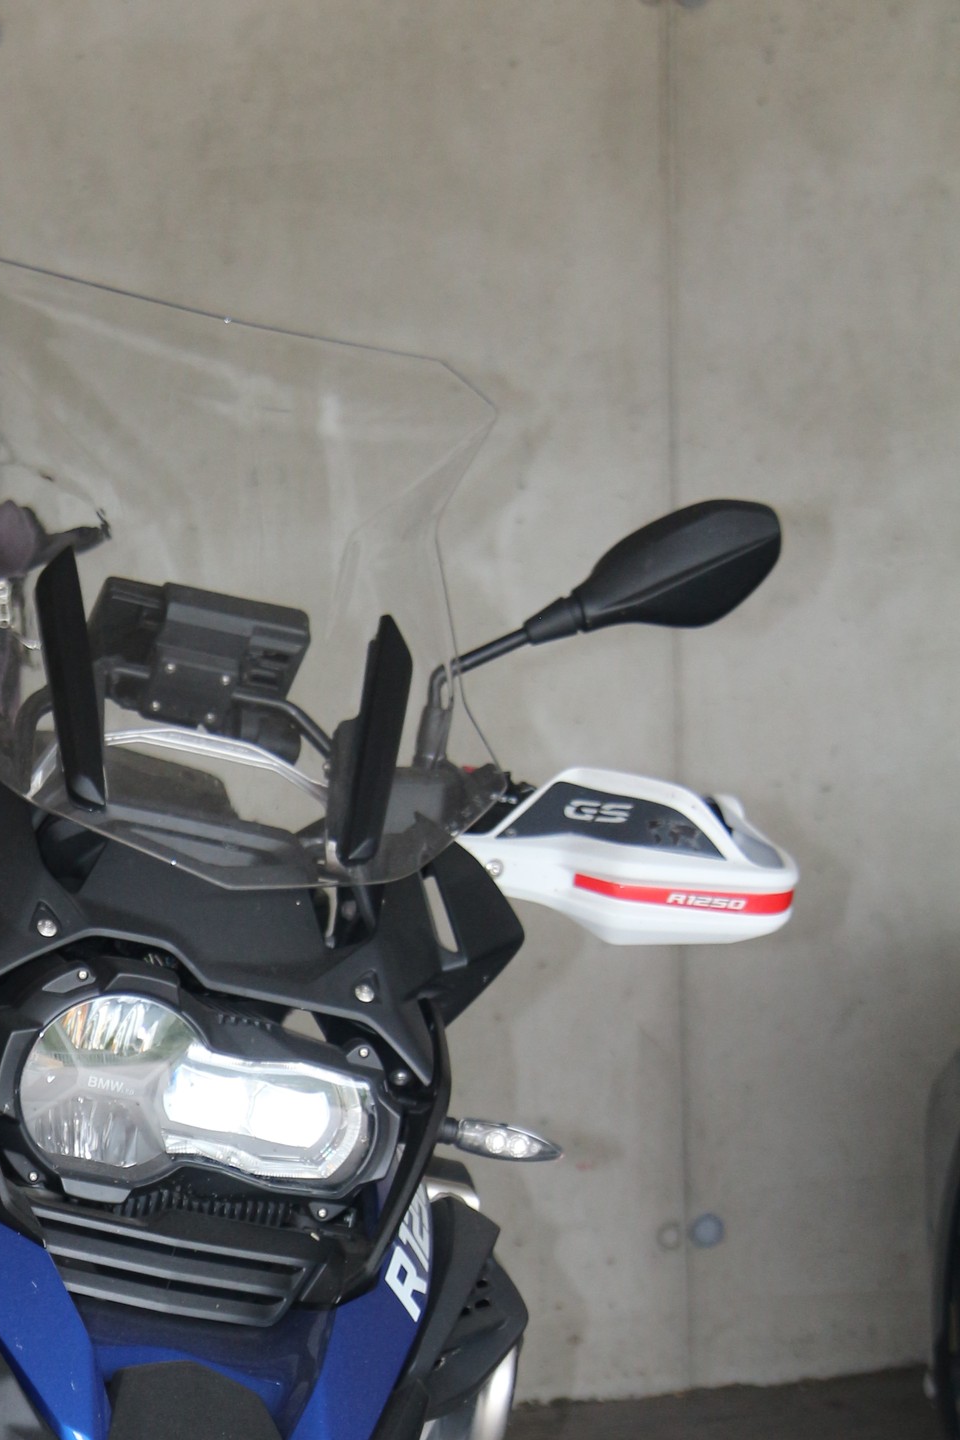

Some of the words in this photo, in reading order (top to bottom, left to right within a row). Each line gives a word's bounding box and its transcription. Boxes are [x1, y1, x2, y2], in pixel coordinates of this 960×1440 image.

[564, 800, 634, 823] GS
[667, 894, 745, 910] R1250
[88, 1076, 123, 1092] BMW
